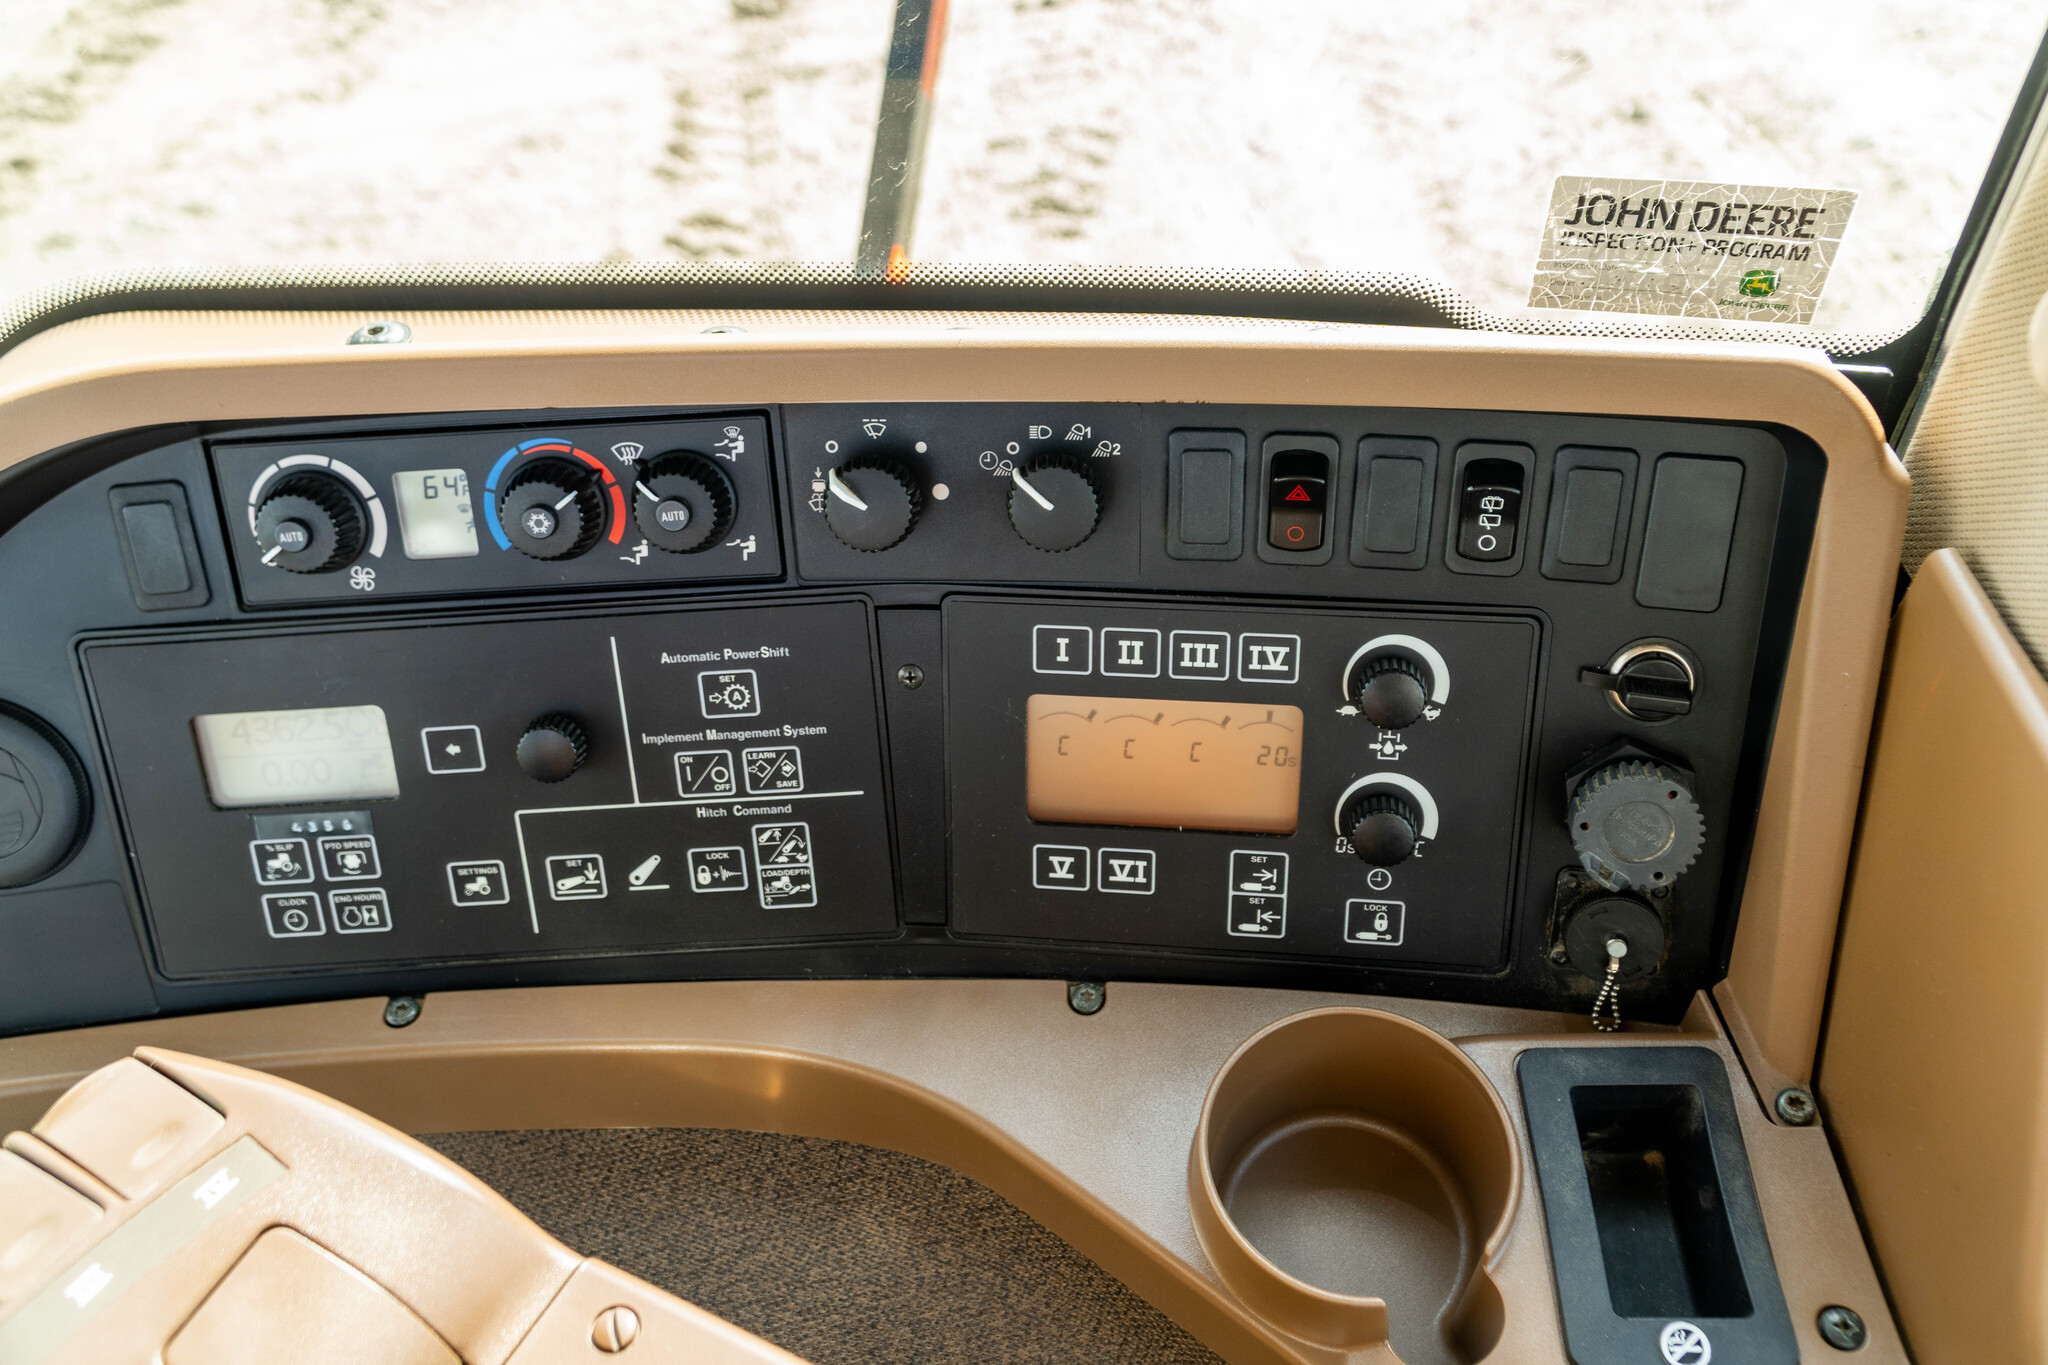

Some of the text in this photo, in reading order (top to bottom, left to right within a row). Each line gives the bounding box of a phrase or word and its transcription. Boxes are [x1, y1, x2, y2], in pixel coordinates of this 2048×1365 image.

[1564, 194, 1826, 239] JOHN DEERE
[1702, 239, 1812, 262] PROGRAM
[661, 510, 686, 524] AUTO
[279, 530, 304, 544] AUTO
[660, 646, 790, 665] Automatic PowerShift
[1180, 642, 1220, 668] III
[1249, 645, 1290, 672] IV
[719, 675, 736, 683] SET
[642, 724, 828, 745] Implement Management System
[679, 756, 693, 764] ON
[747, 752, 776, 760] LEARN
[714, 783, 731, 791] OFF
[776, 780, 799, 788] SAVE
[696, 804, 792, 818] Hitch Command
[275, 843, 295, 852] SLIP
[324, 840, 371, 850] PTO SPEED
[706, 851, 729, 860] LOCK
[566, 860, 582, 868] SET
[1048, 855, 1075, 879] V
[457, 866, 499, 876] SETTINGS
[762, 868, 811, 877] LOAD/DEPTH
[1108, 859, 1147, 883] VI
[277, 898, 308, 907] CLOCK
[334, 893, 385, 904] ENG HOURS
[1249, 897, 1266, 905] SET
[1364, 904, 1388, 912] LOCK
